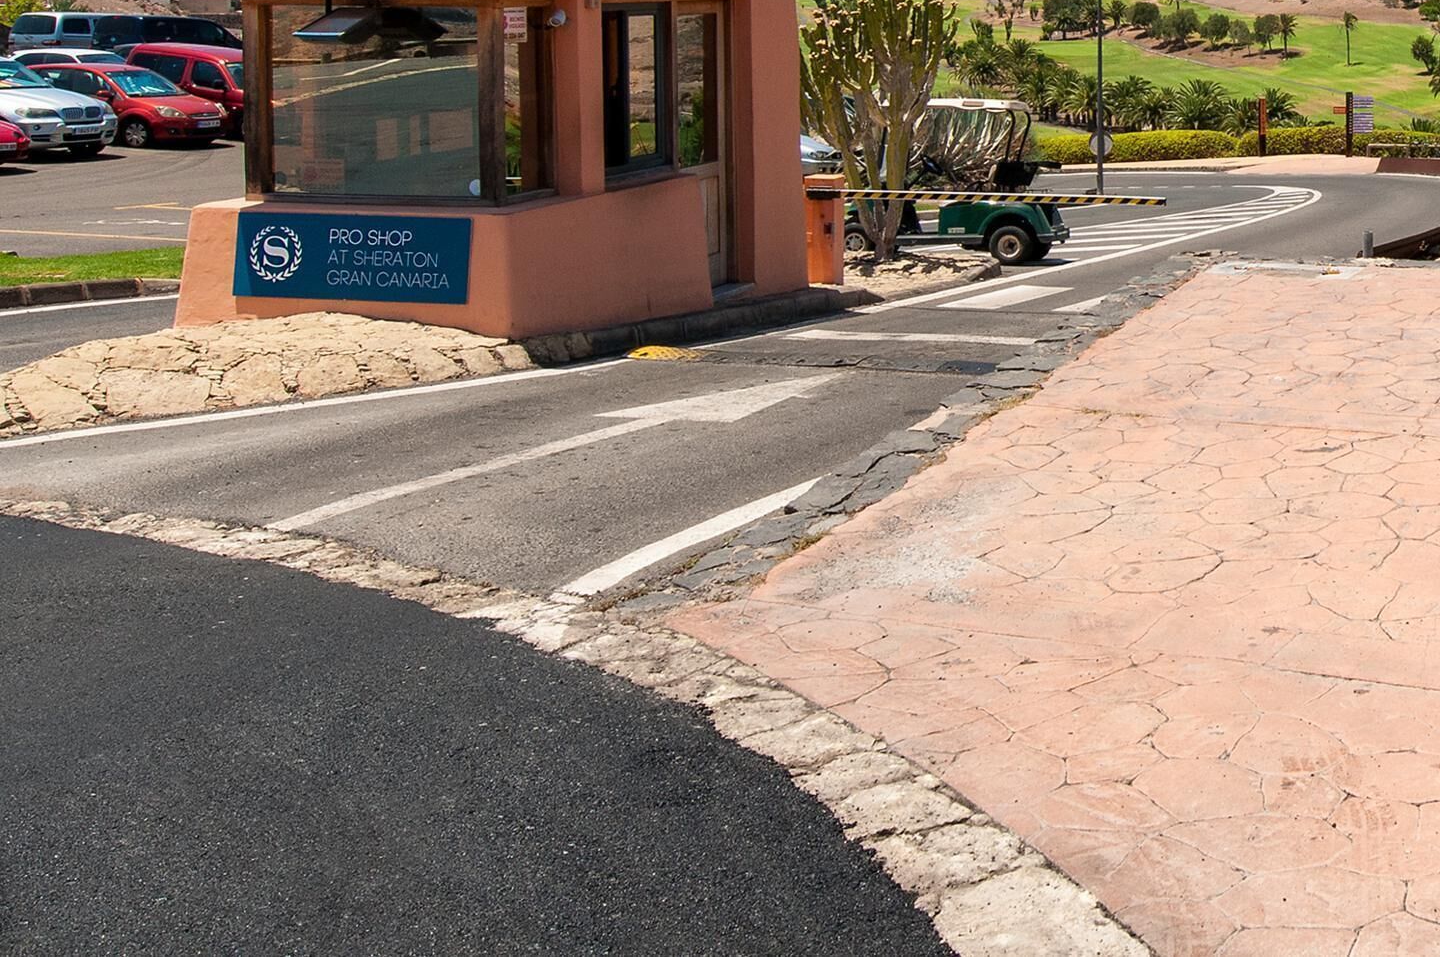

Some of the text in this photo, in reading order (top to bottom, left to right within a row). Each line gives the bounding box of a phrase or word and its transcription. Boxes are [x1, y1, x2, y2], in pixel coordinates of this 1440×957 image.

[329, 228, 413, 247] PRO SHOP
[327, 249, 438, 268] AT SHERATON
[326, 269, 449, 289] GRAN CANARIA
